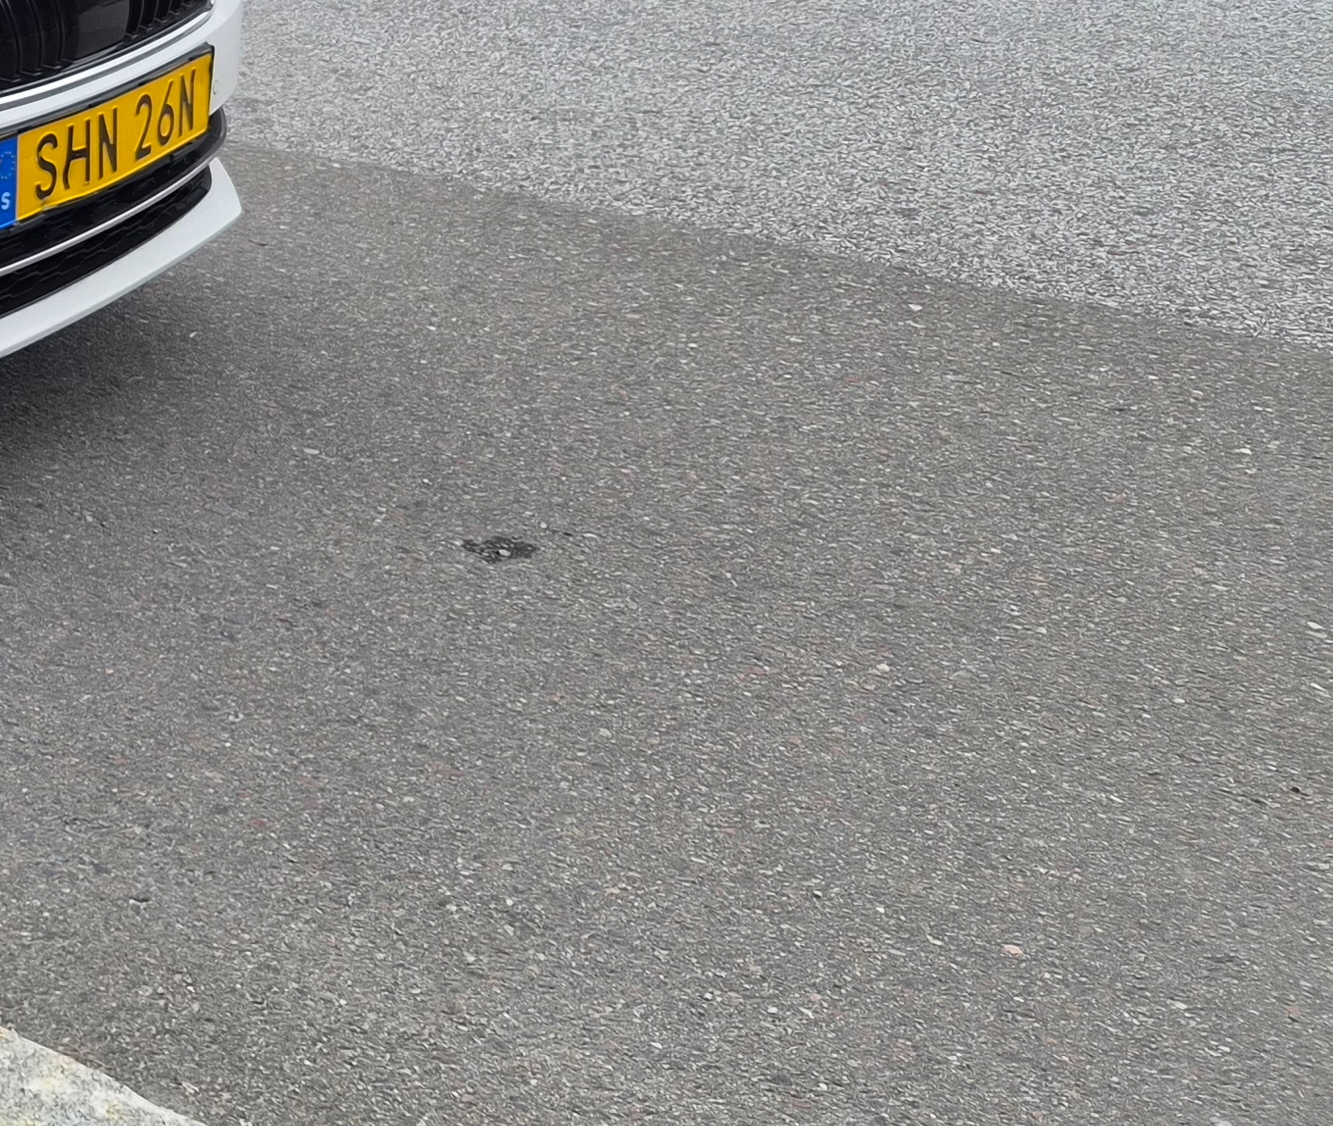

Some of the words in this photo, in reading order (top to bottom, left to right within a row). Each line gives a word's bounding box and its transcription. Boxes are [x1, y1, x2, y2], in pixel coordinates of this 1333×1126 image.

[34, 106, 119, 201] SHN
[134, 67, 197, 162] 26N
[0, 191, 11, 211] S
